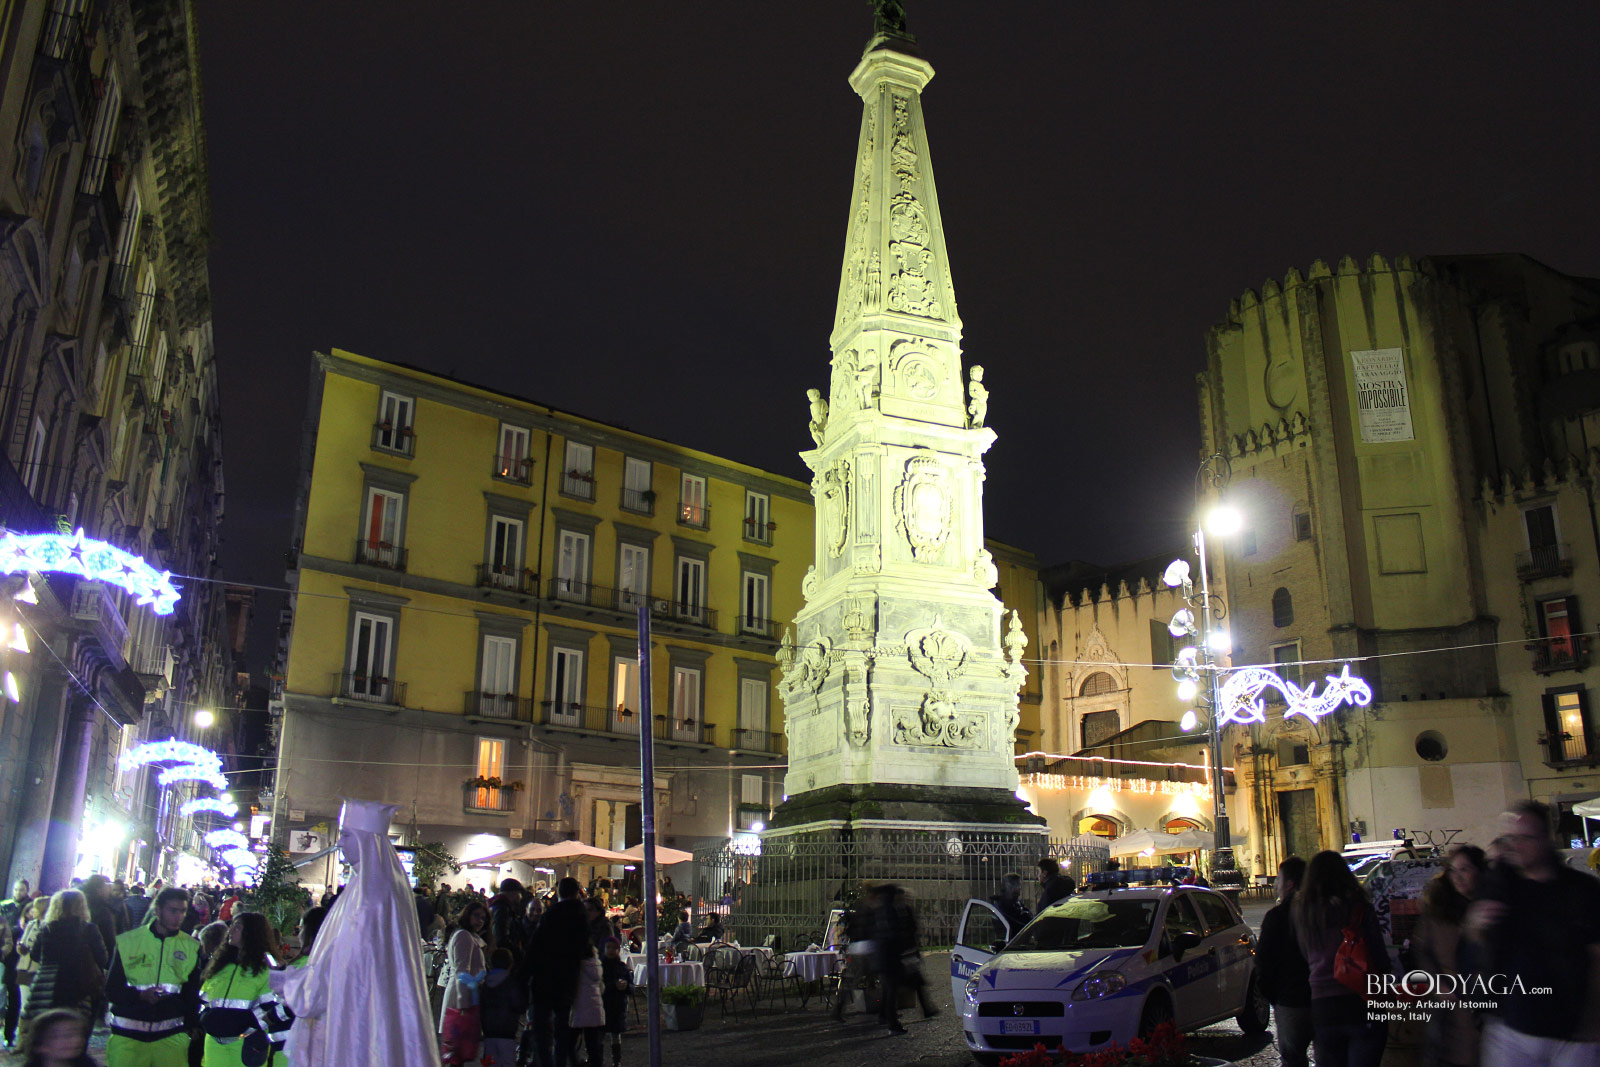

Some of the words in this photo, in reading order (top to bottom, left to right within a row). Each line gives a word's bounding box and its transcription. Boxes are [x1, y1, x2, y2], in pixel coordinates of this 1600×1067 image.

[1355, 370, 1402, 378] CARAVAGGIO
[1358, 380, 1404, 390] MOSTRA
[1358, 388, 1406, 409] IMPOSSIBILE
